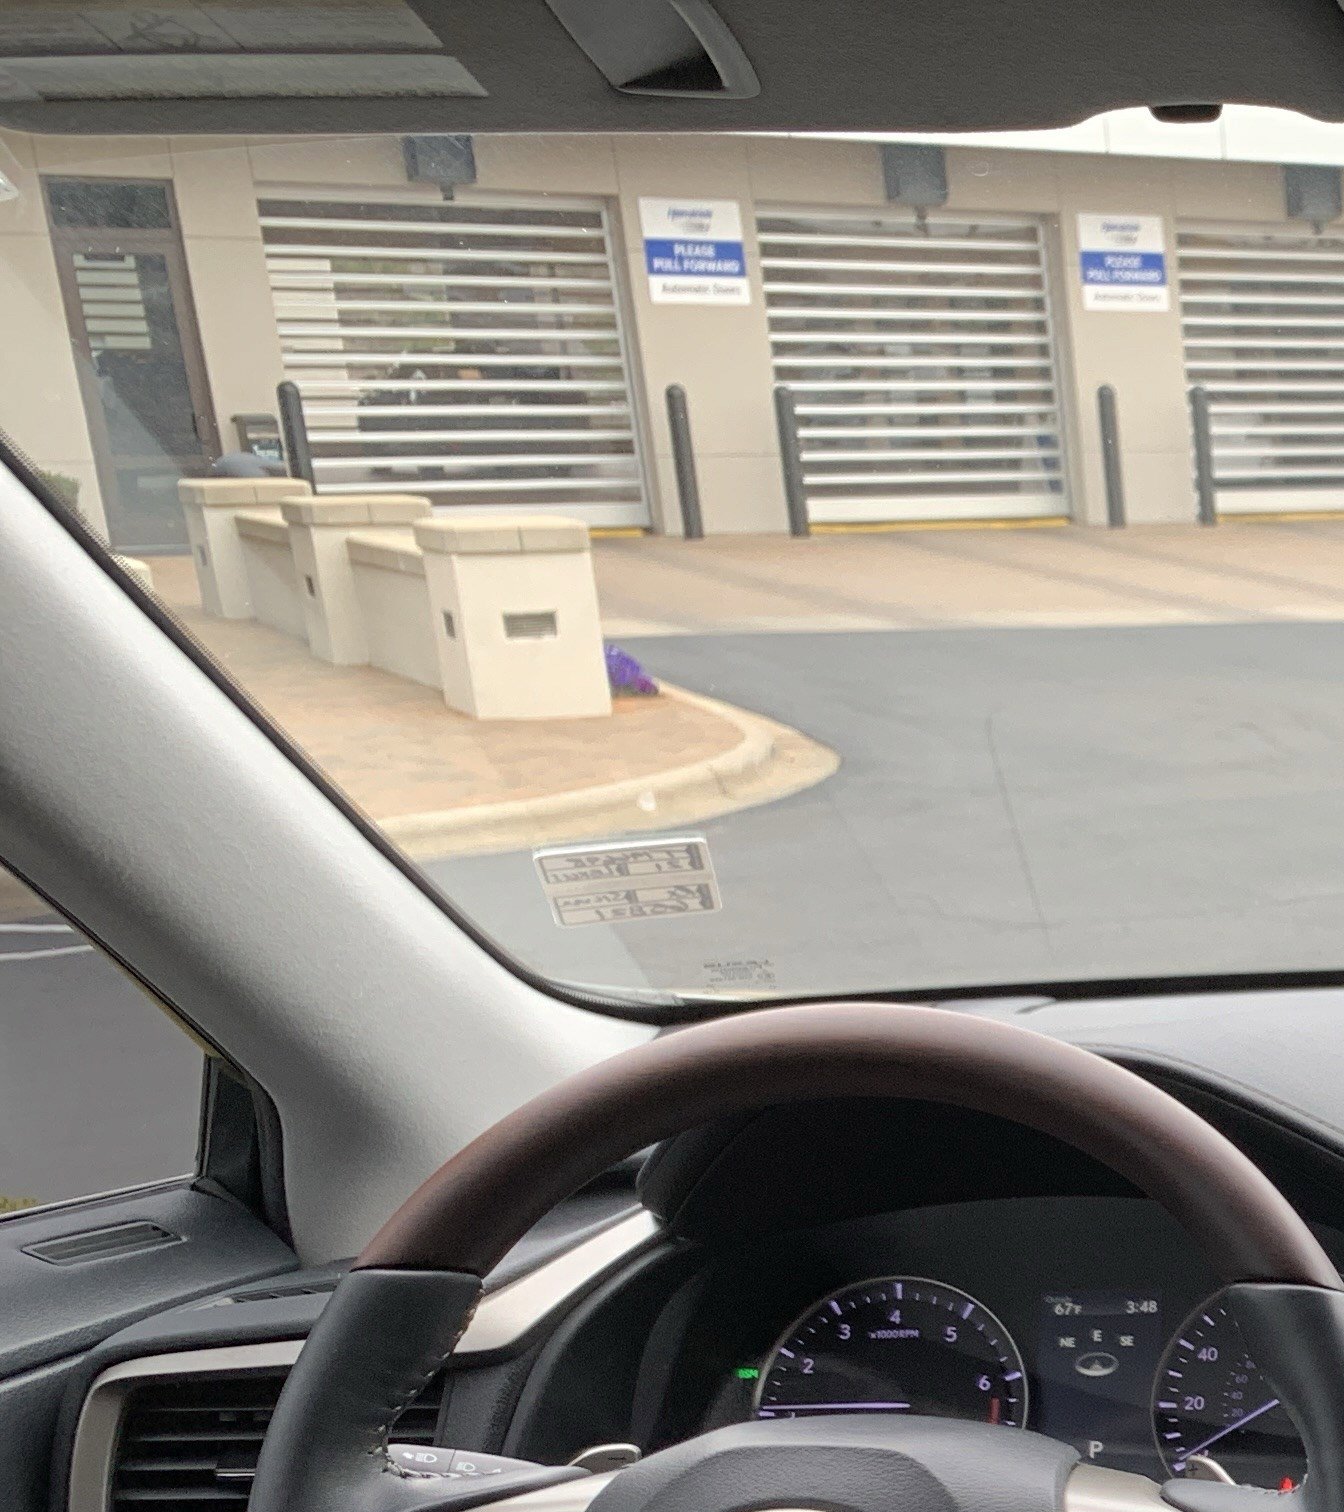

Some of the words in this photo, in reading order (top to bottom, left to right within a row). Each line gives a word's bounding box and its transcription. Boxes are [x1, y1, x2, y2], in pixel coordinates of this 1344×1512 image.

[673, 243, 715, 257] PLEASE
[653, 257, 681, 272] PULL
[683, 259, 740, 274] FORWARD
[1126, 1300, 1158, 1314] 3:48
[889, 1309, 901, 1325] 4
[838, 1323, 852, 1340] 3
[944, 1326, 958, 1343] 5
[1058, 1336, 1076, 1348] NE
[1092, 1328, 1103, 1343] E
[1198, 1346, 1219, 1363] 40
[803, 1358, 815, 1375] 2
[978, 1375, 991, 1391] 6
[1184, 1395, 1205, 1411] 20
[1088, 1441, 1104, 1459] P
